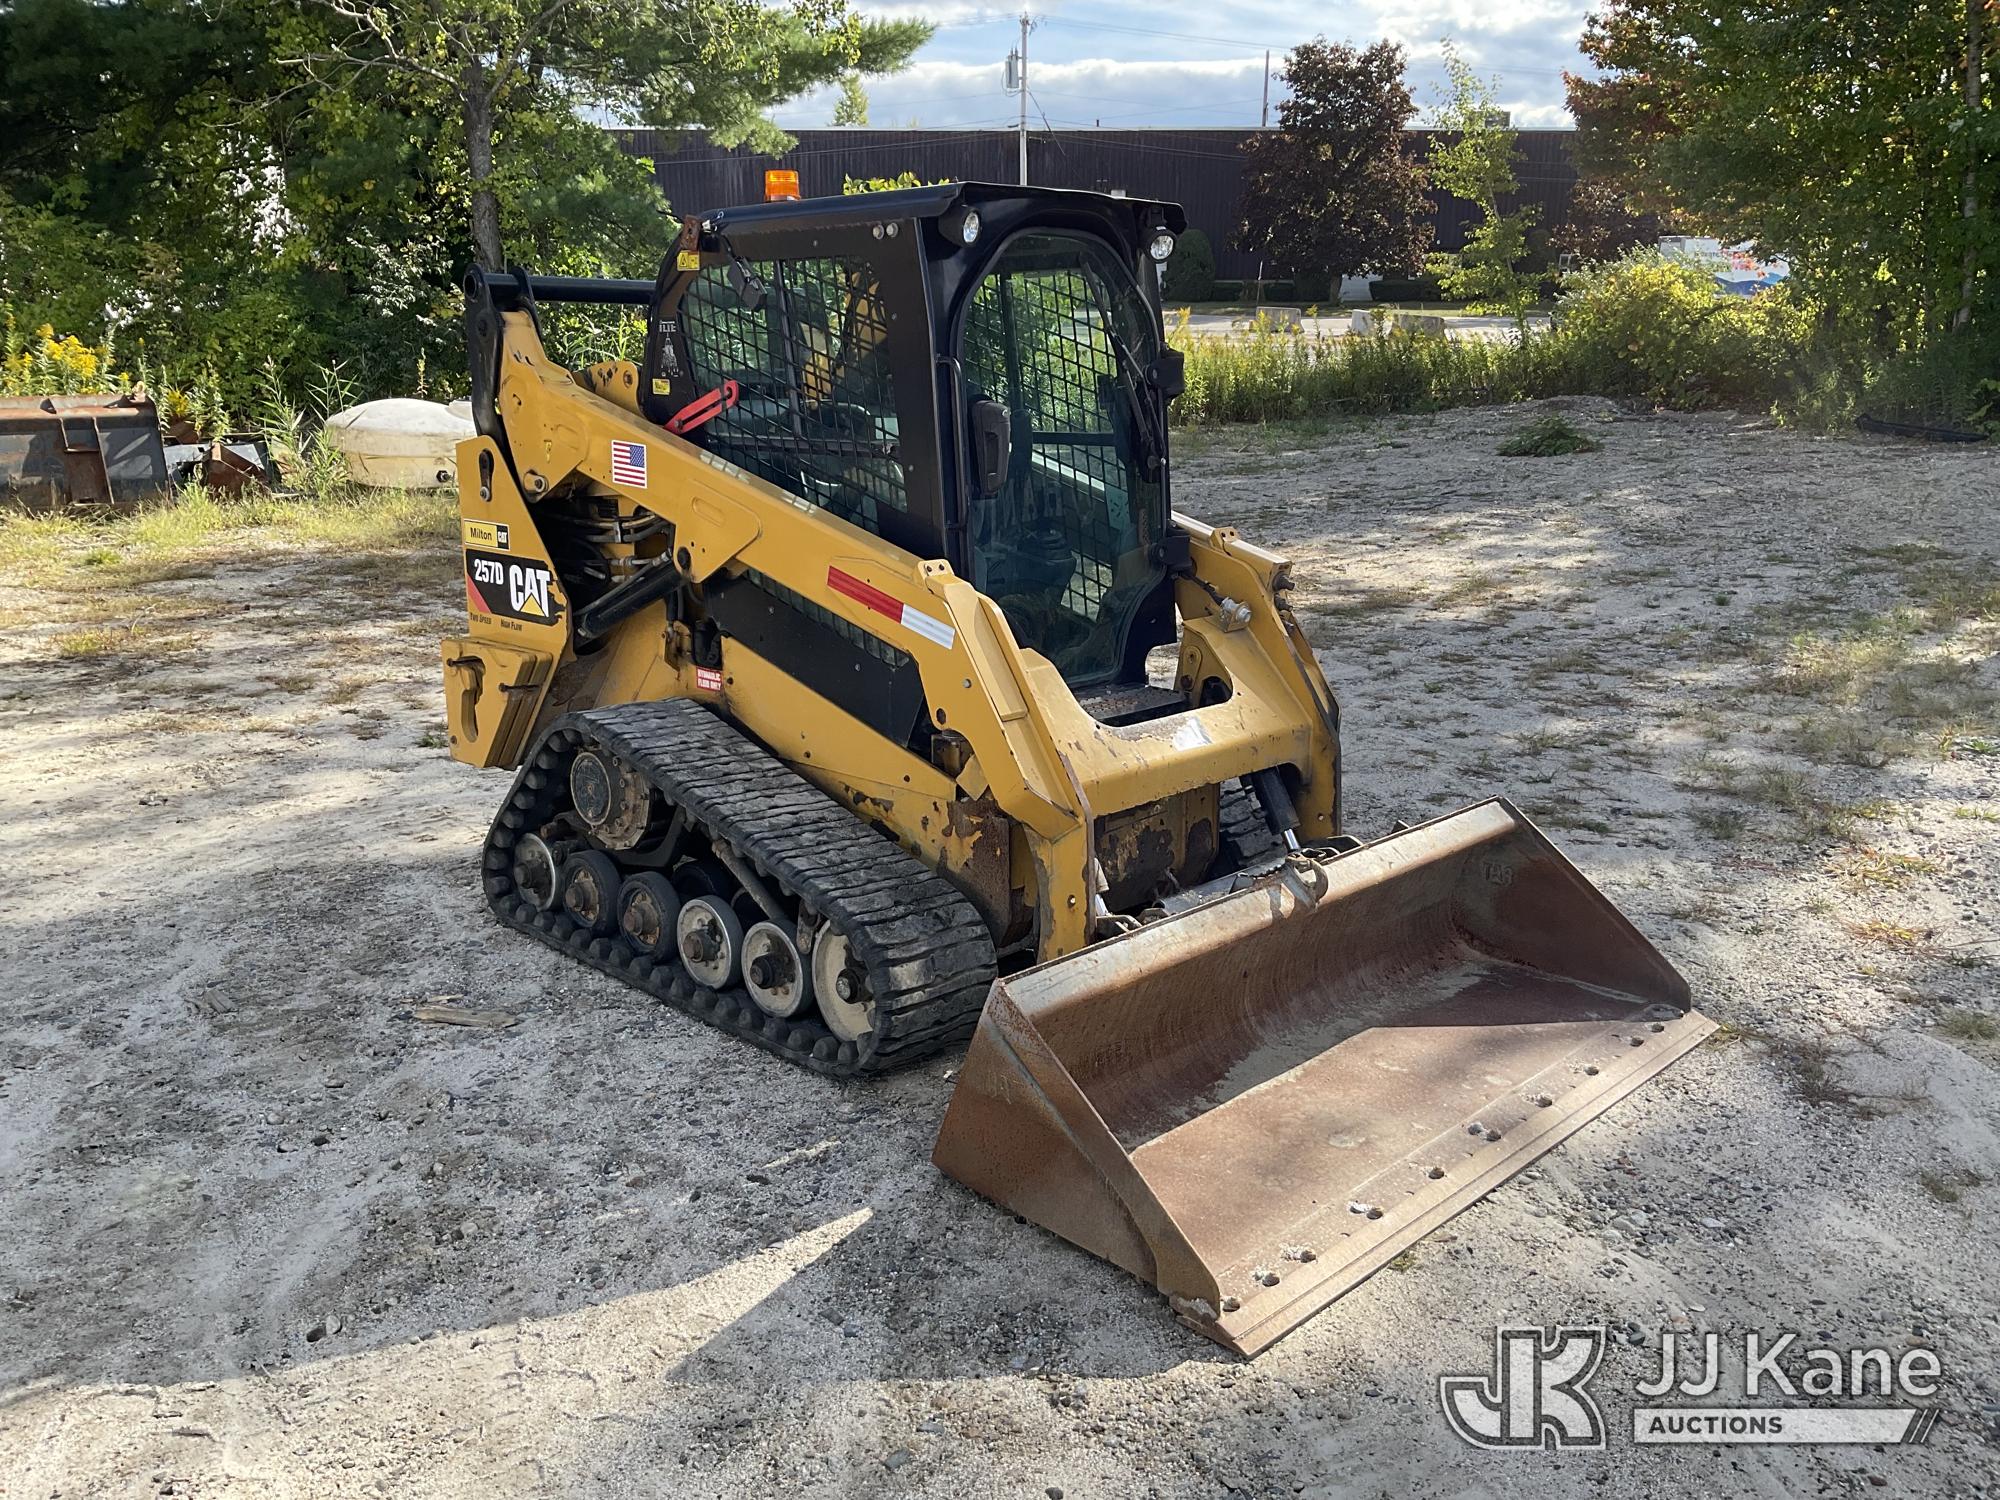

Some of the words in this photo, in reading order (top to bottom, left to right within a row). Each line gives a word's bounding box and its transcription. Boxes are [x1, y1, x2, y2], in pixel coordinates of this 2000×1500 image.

[470, 527, 492, 540] Milton
[497, 531, 508, 543] CAT
[474, 559, 504, 585] 257D
[509, 565, 550, 617] CAT
